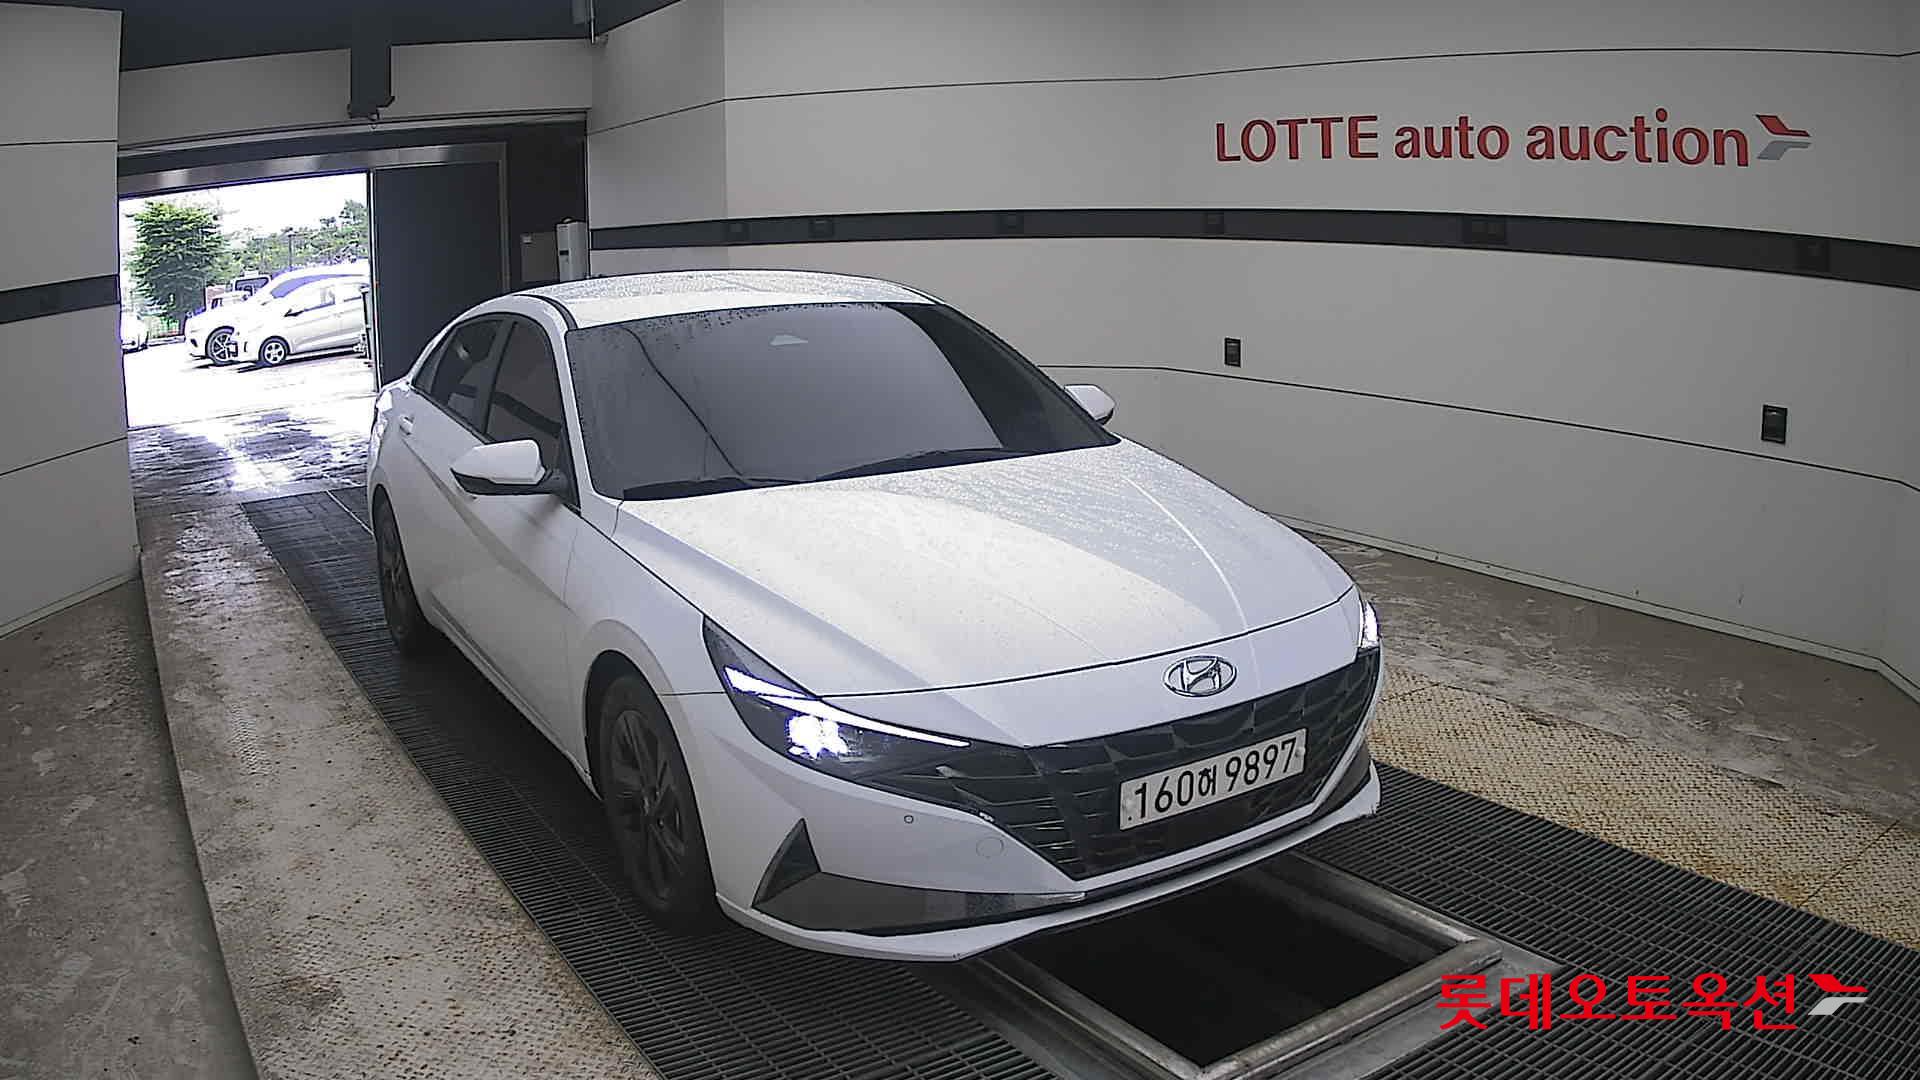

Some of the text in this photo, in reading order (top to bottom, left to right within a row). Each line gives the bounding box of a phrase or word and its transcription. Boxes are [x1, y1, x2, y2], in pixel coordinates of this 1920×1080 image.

[1216, 107, 1750, 168] LOTTE auto auction
[1134, 736, 1297, 819] 160허 9897
